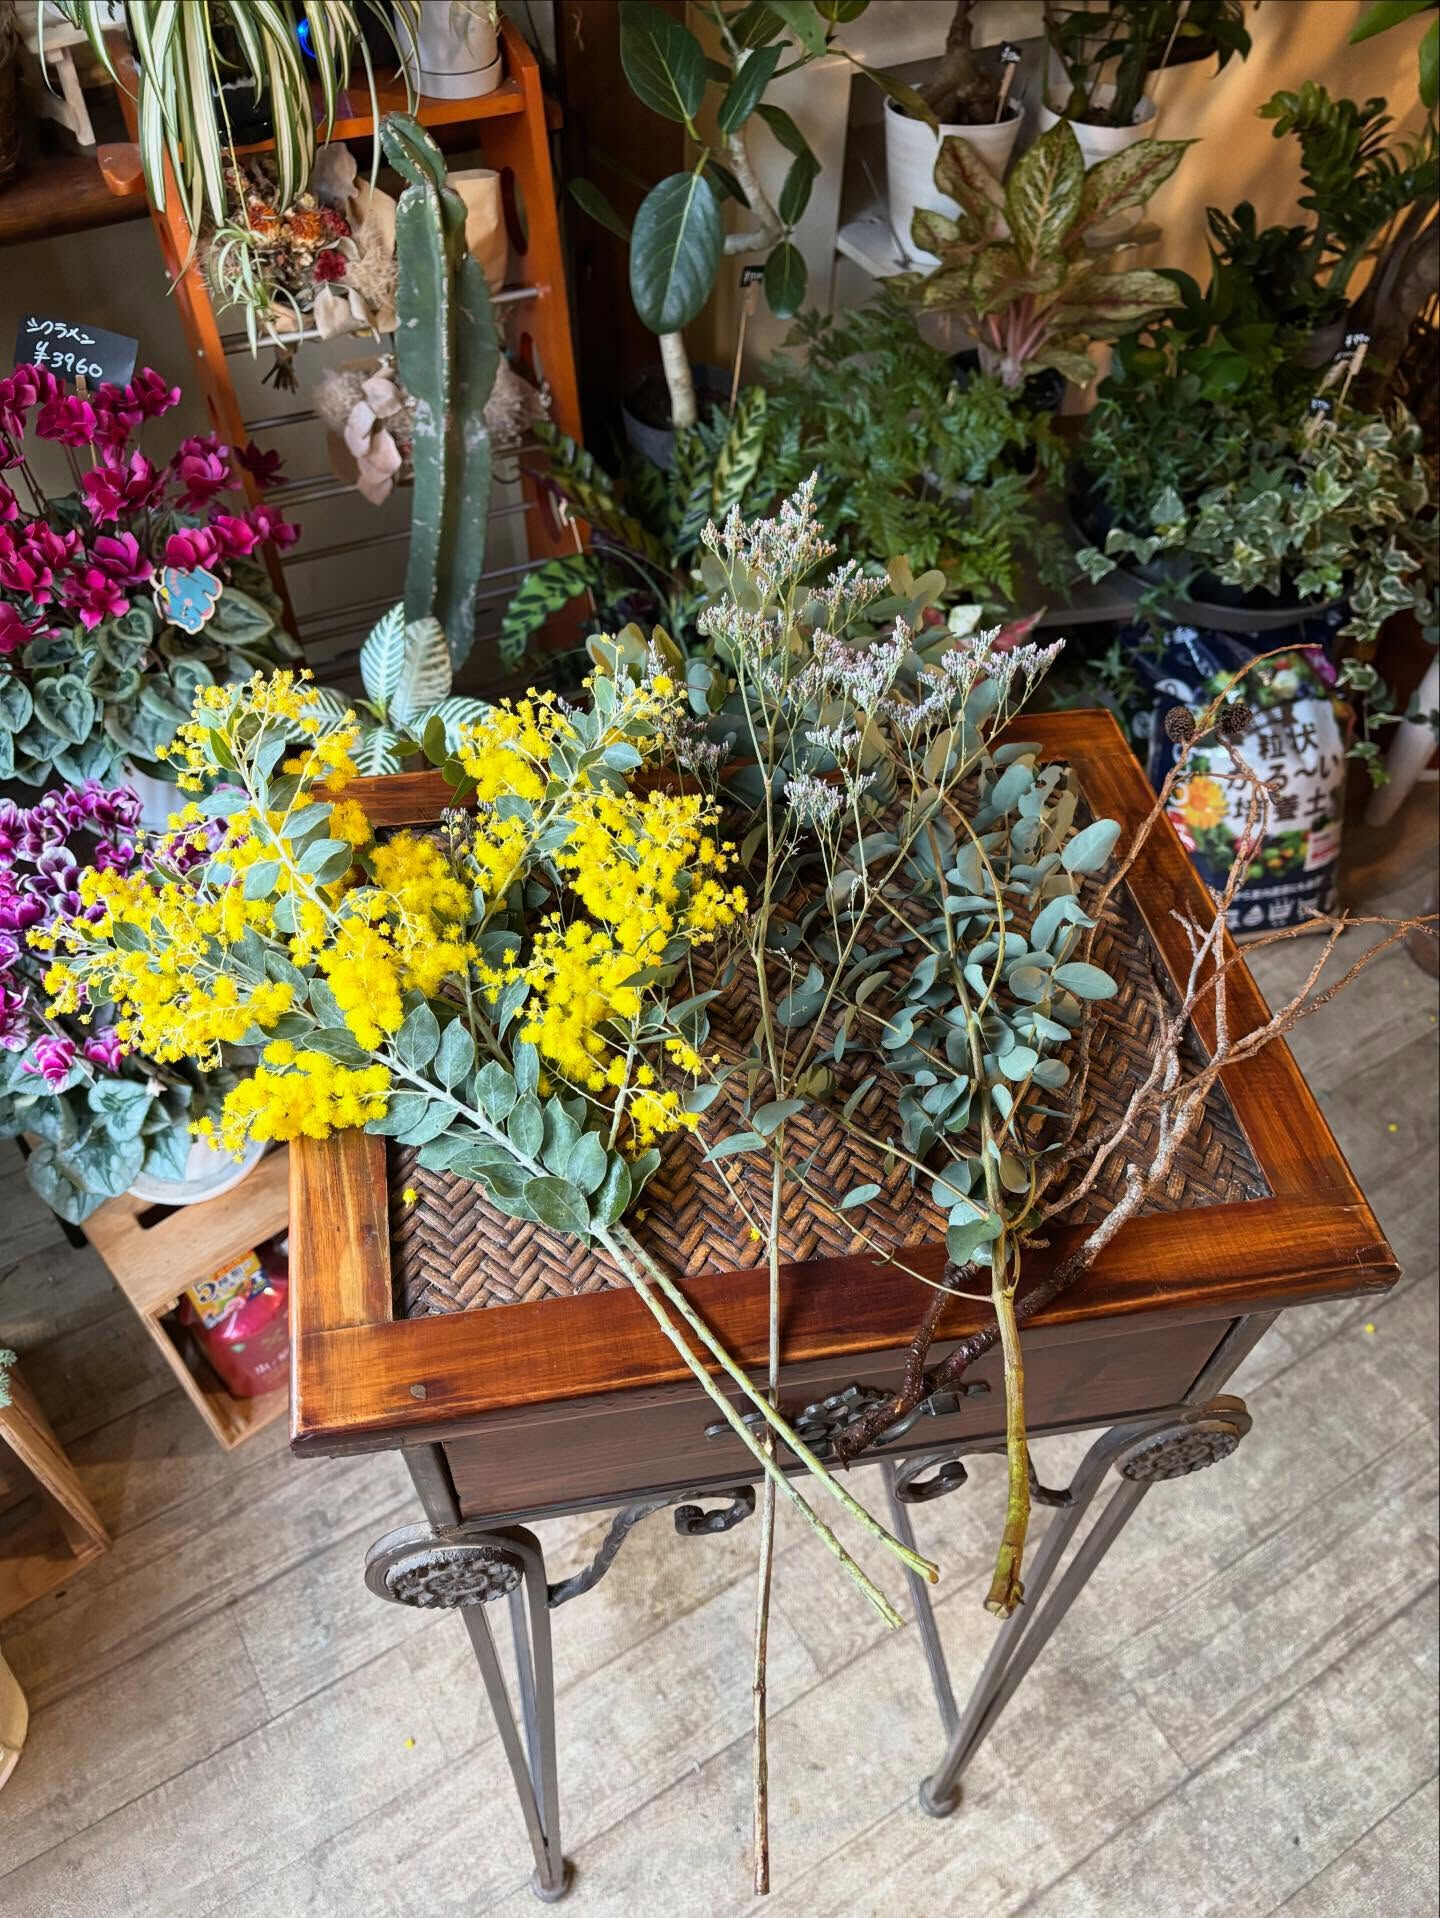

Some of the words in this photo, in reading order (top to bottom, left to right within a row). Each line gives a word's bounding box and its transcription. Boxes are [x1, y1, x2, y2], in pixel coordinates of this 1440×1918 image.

[26, 317, 96, 345] シクラメン
